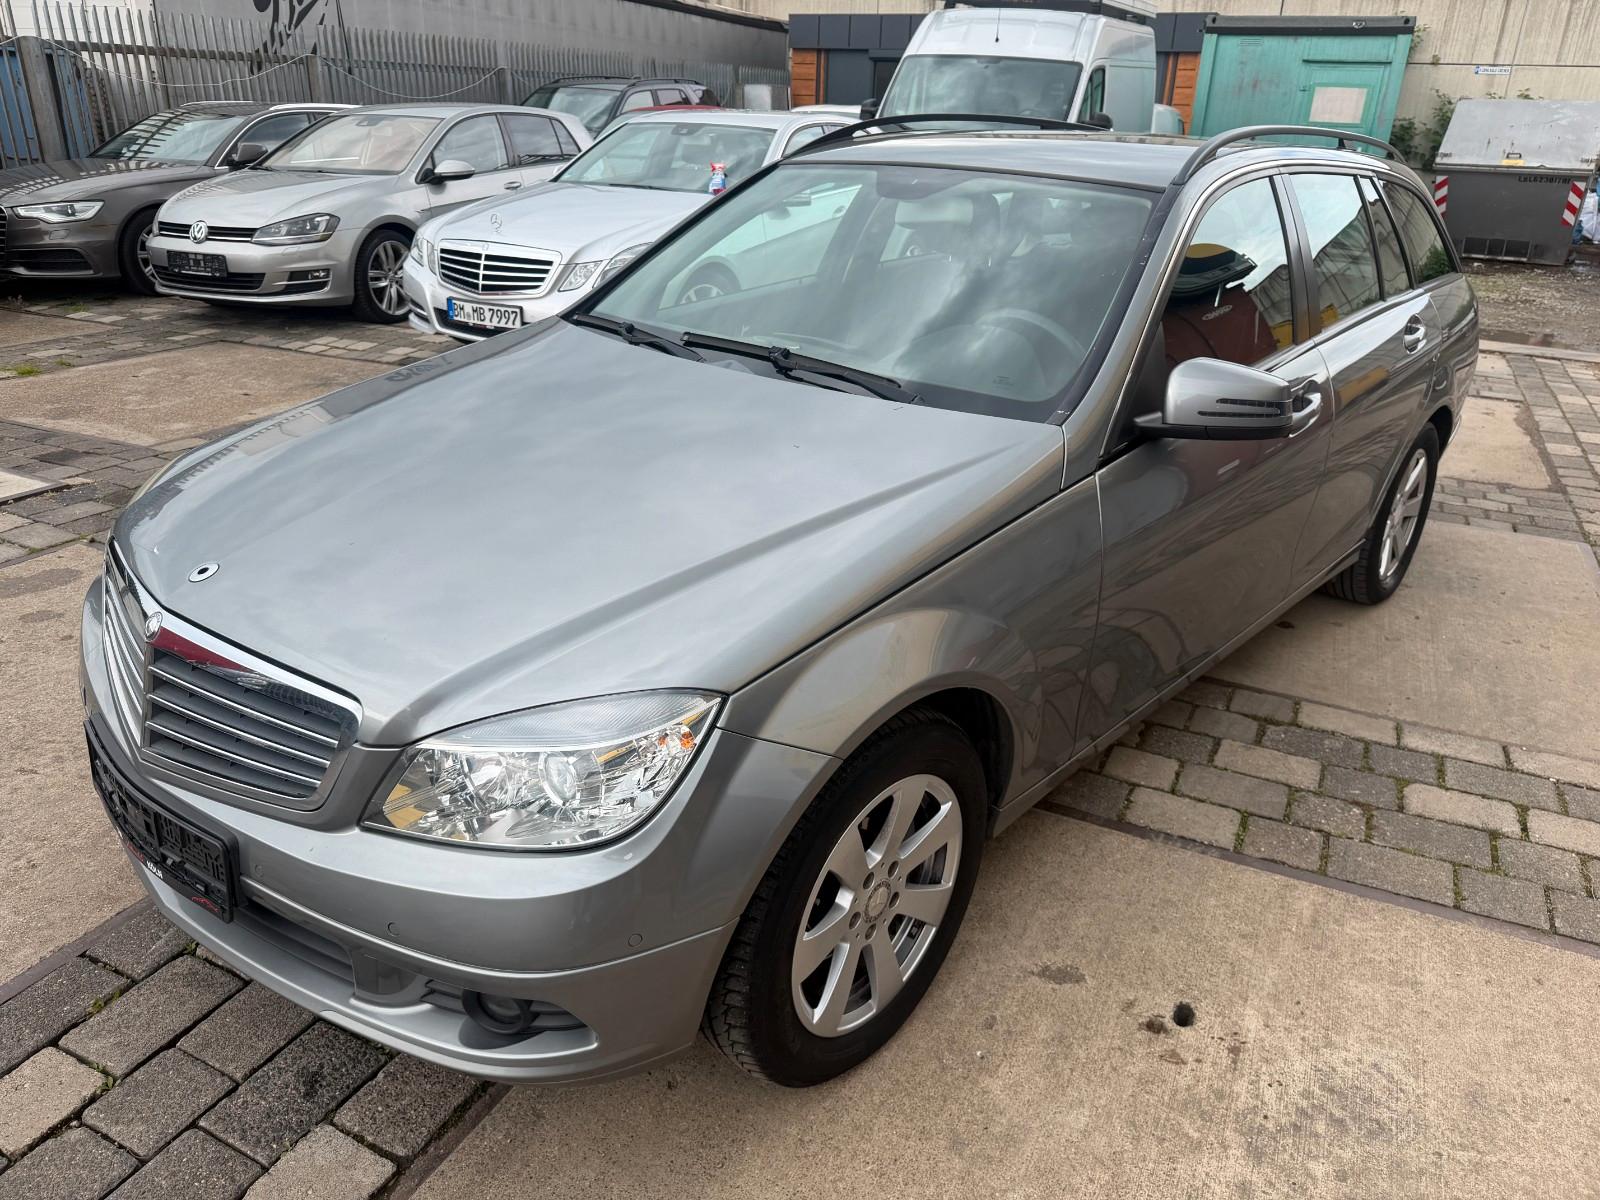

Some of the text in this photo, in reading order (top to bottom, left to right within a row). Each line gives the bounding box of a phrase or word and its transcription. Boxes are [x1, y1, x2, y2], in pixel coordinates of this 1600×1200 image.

[454, 303, 518, 326] BM MB 7997
